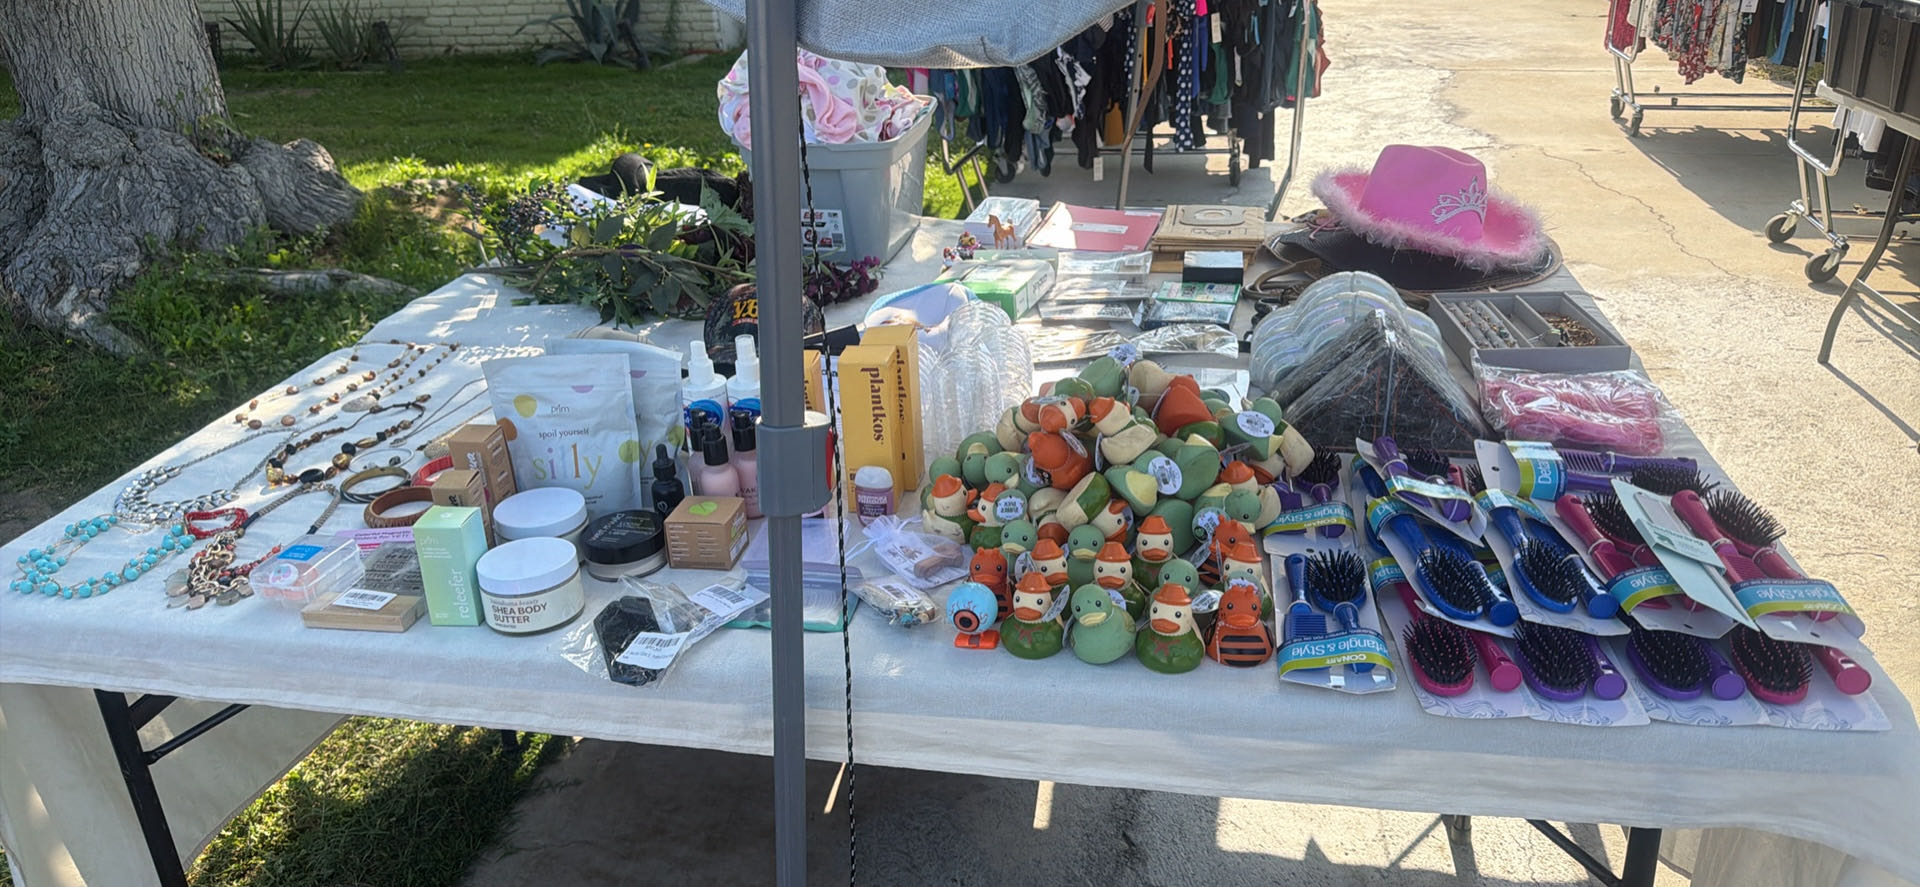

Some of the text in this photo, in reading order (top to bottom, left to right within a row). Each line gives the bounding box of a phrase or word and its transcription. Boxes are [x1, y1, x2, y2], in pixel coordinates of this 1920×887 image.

[861, 366, 887, 442] plantkos
[538, 427, 590, 440] spoil yourself
[532, 442, 602, 490] silly
[1630, 575, 1667, 589] Style
[448, 568, 470, 618] releefer
[1756, 587, 1796, 600] Style
[492, 602, 547, 615] SHEA BODY
[493, 614, 530, 624] BUTTER
[1291, 637, 1388, 657] etangle & Style
[1325, 653, 1367, 665] CONAIR
